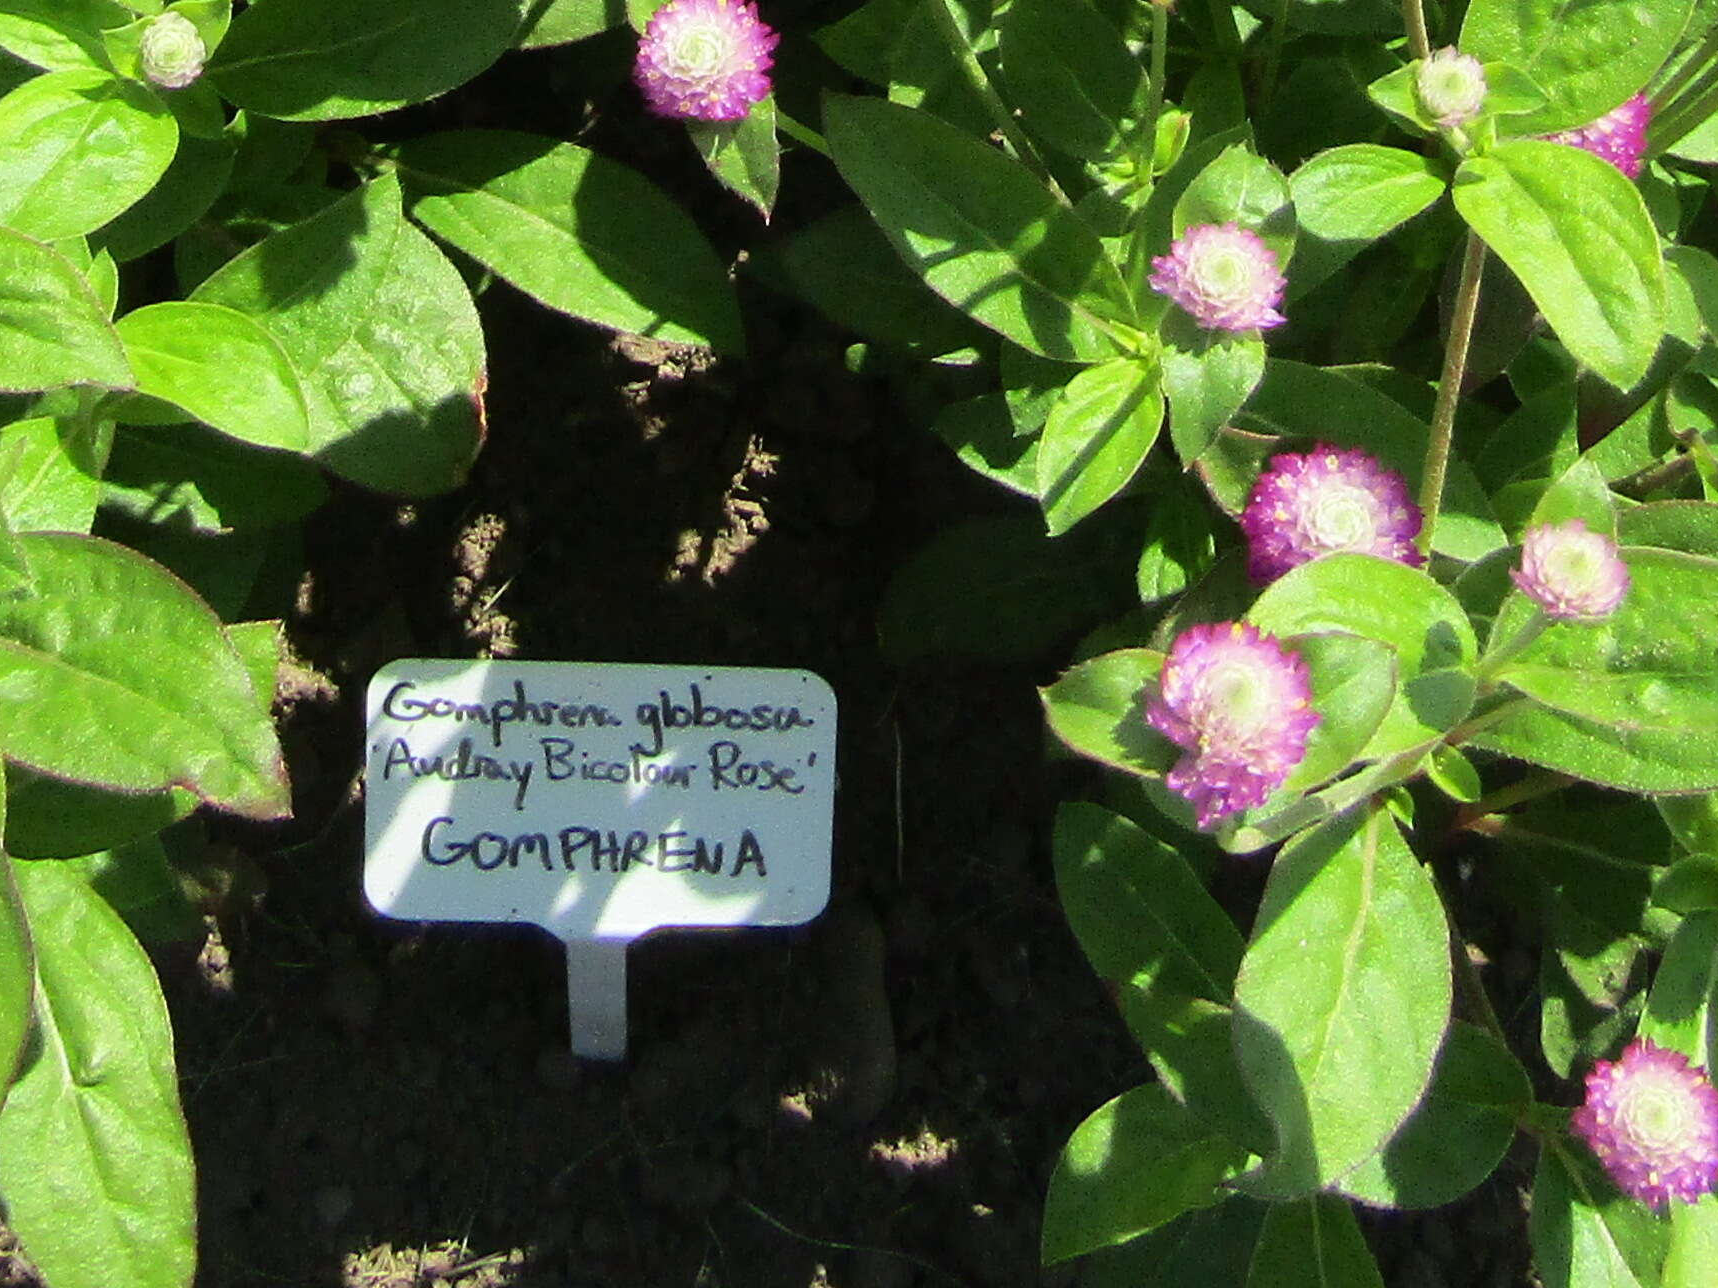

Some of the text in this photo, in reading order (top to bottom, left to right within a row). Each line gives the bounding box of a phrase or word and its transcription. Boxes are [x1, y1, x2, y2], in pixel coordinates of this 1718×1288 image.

[382, 679, 814, 757] Gomphrena globosa
[421, 815, 768, 878] GOMPHRENA
